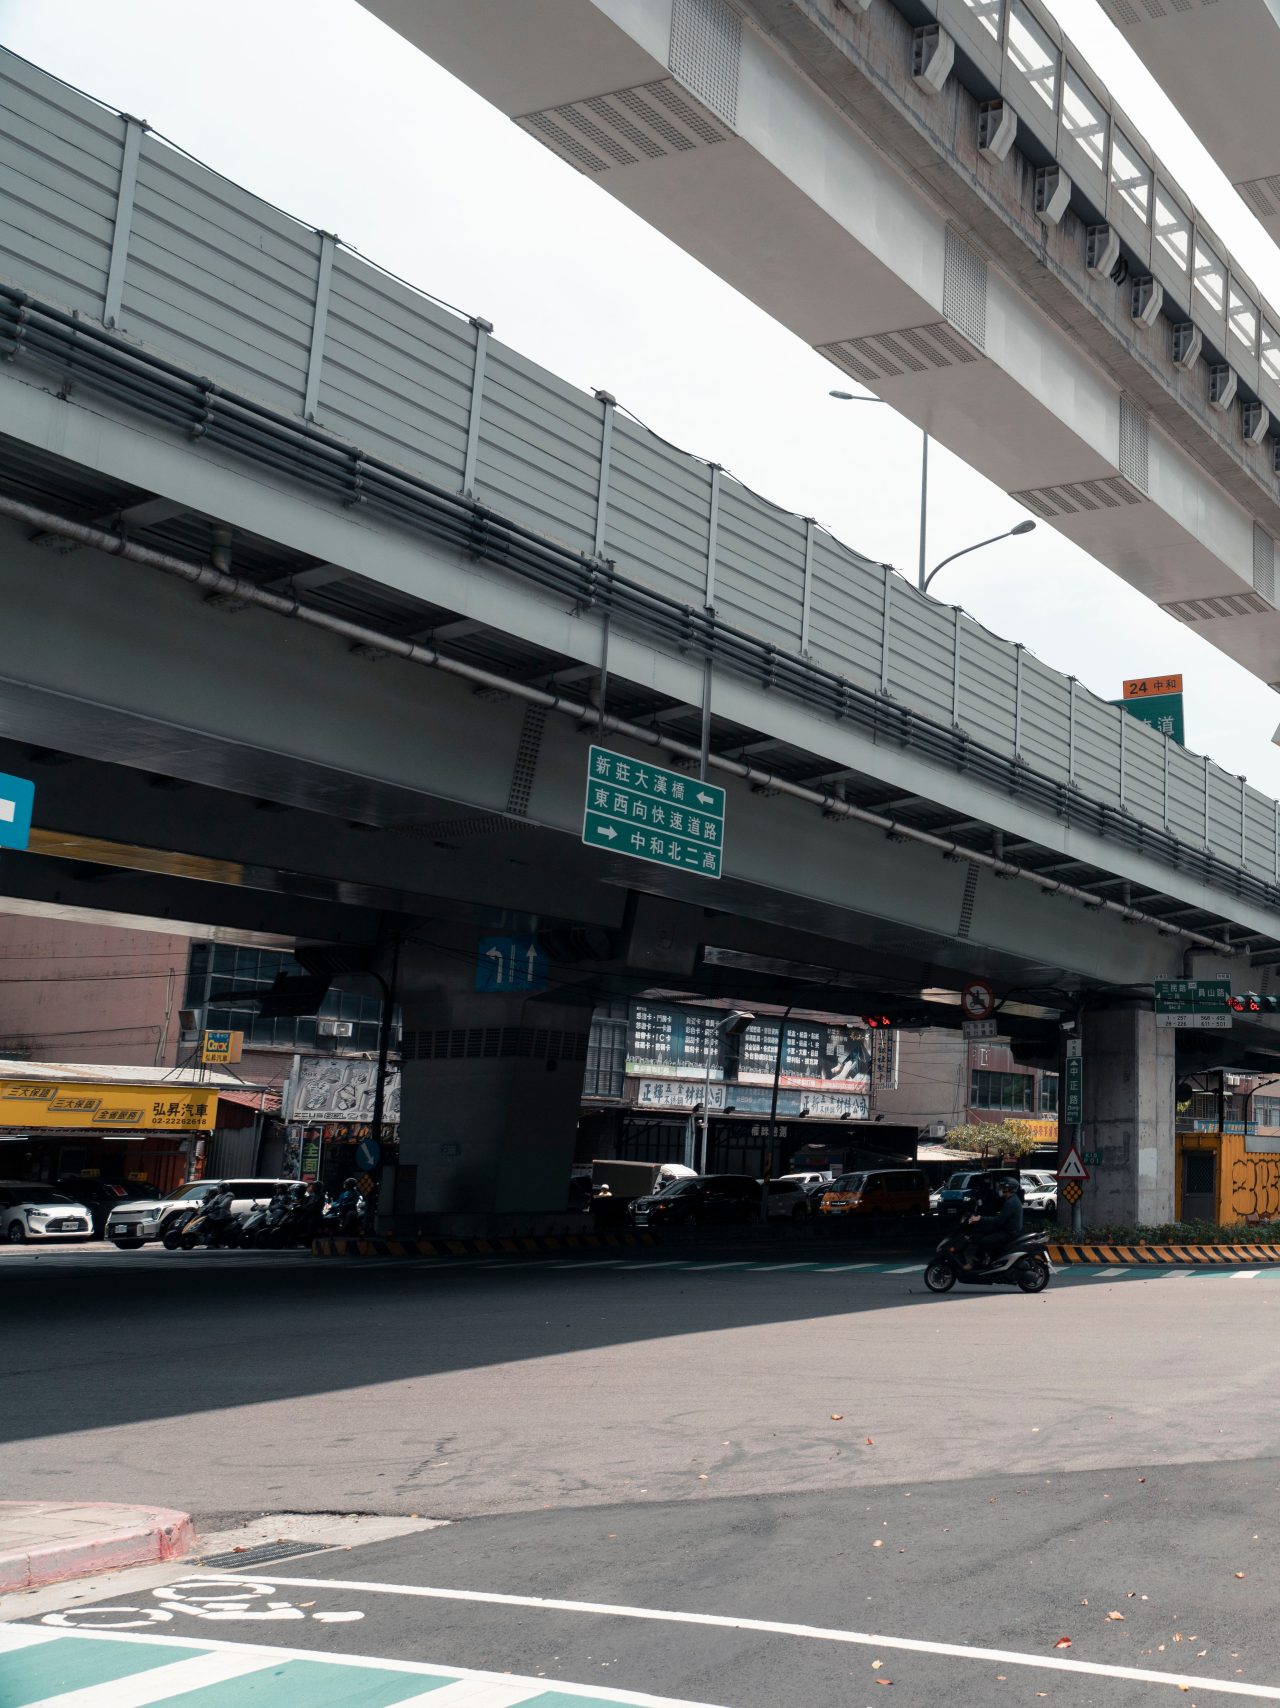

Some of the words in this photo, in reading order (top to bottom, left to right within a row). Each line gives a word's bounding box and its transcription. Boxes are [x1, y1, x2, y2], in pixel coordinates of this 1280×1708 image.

[1129, 682, 1148, 695] 24
[1153, 679, 1177, 692] 中和
[595, 755, 685, 801] 新莊大漢橋
[594, 788, 717, 841] 東西向快速道路
[630, 831, 717, 871] 中和北二高
[1161, 983, 1187, 993] 三民路
[1069, 1067, 1079, 1105] 中正路
[152, 1102, 208, 1117] 弘昇汽車
